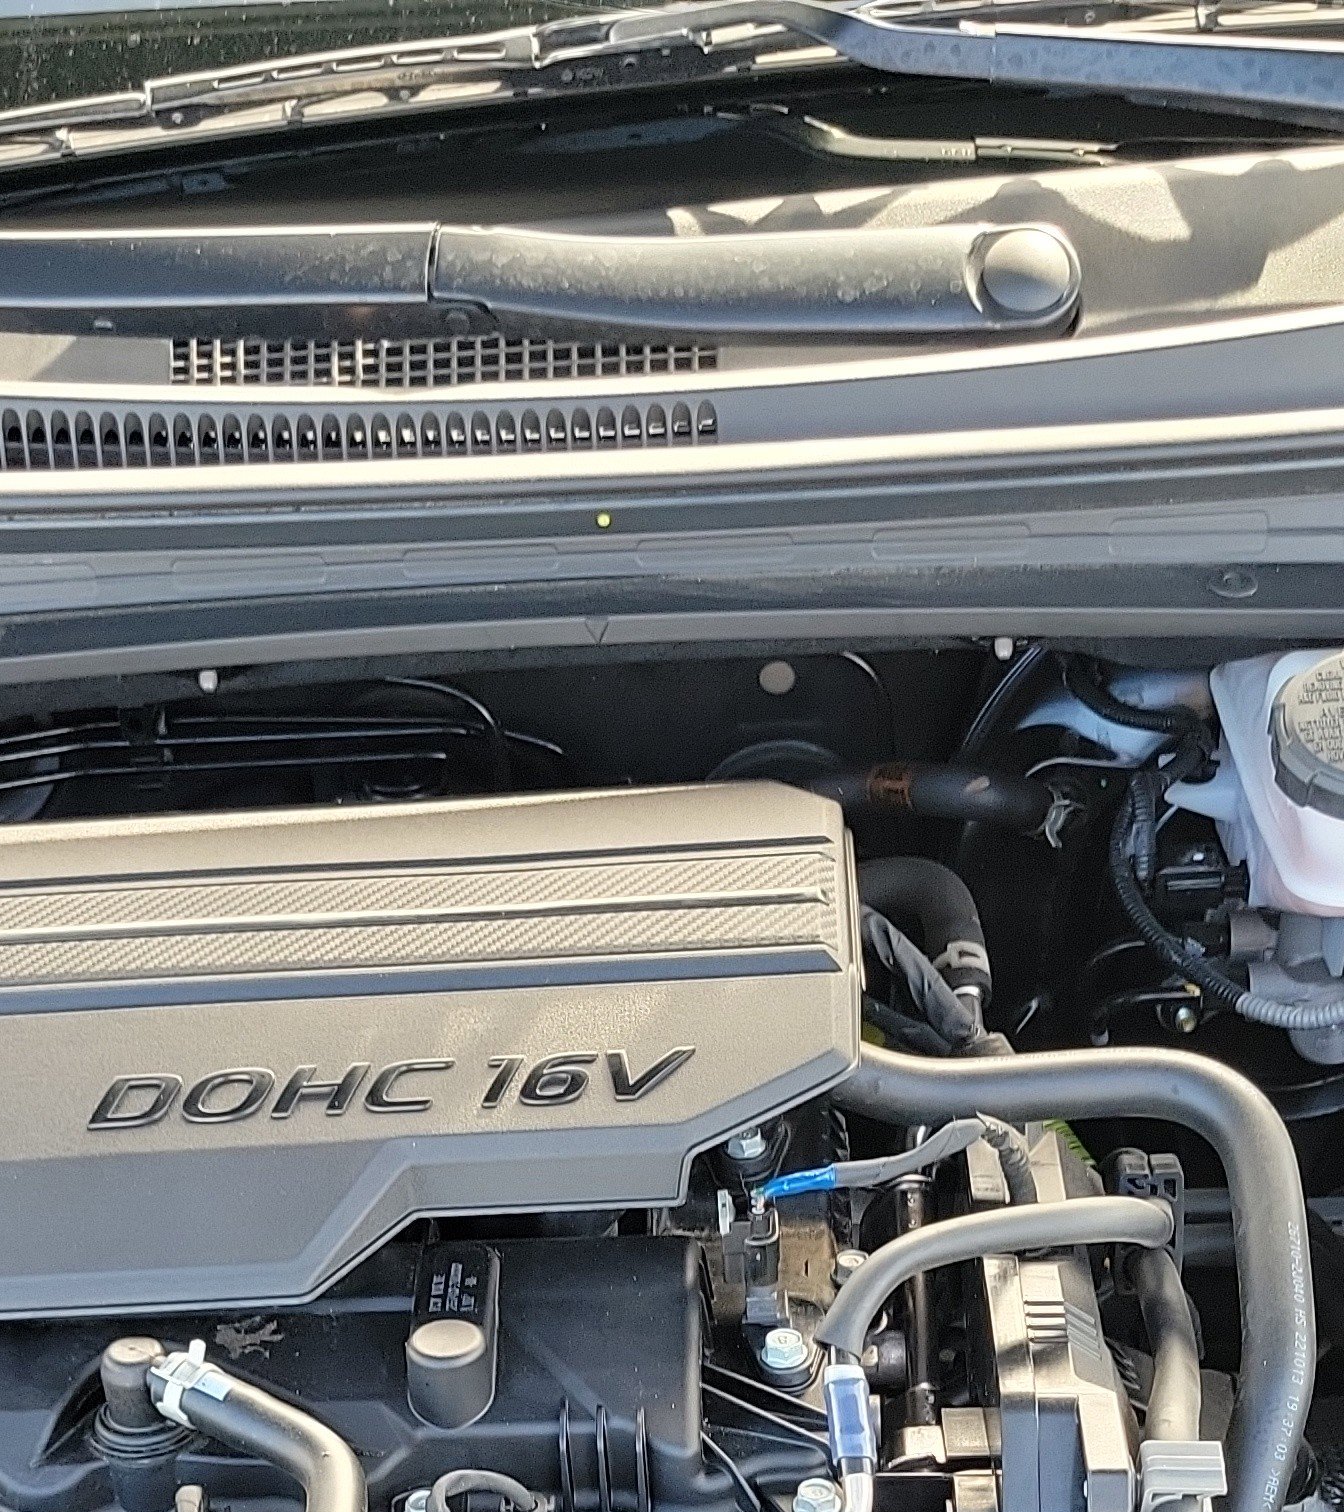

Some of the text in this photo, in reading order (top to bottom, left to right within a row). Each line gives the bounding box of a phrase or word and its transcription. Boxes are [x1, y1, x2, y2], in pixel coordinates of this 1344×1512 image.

[87, 1045, 697, 1131] DOHC 16V
[1291, 1331, 1307, 1386] 221013
